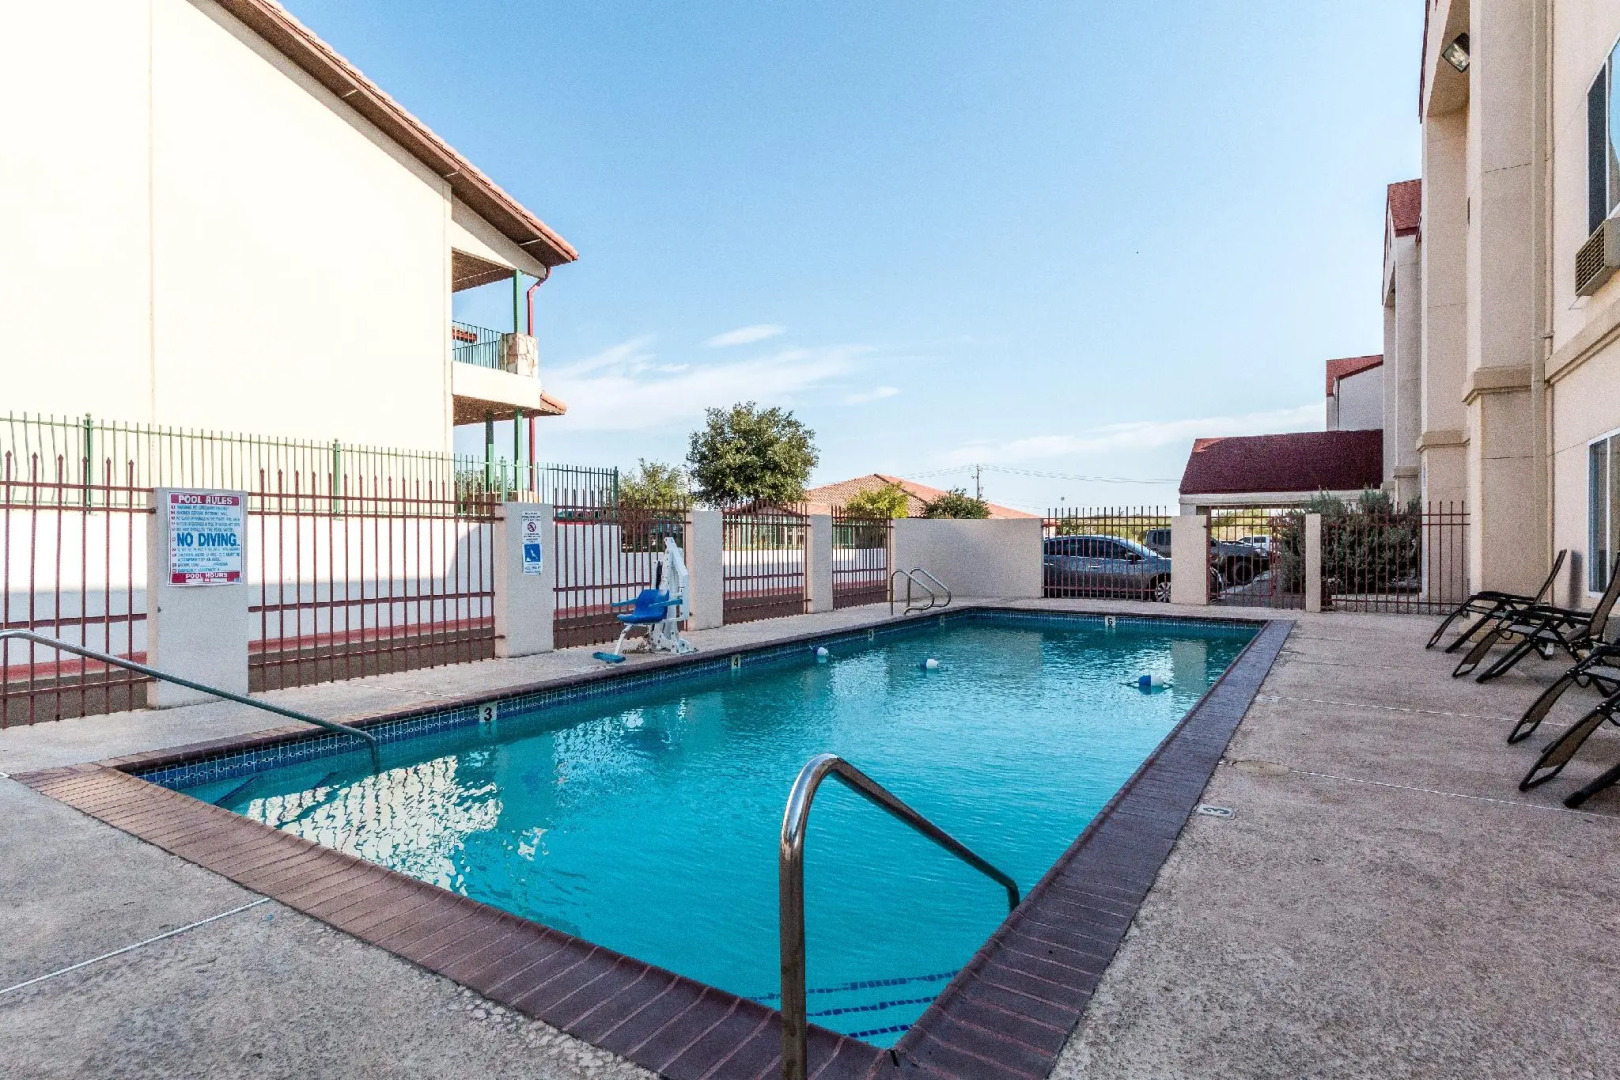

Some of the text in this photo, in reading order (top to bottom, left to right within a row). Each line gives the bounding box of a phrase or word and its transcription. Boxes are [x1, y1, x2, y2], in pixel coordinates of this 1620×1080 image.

[178, 495, 233, 505] POOL RULES
[176, 532, 194, 547] NO
[733, 656, 739, 668] 4
[483, 706, 493, 721] 3
[1202, 807, 1231, 815] 3
